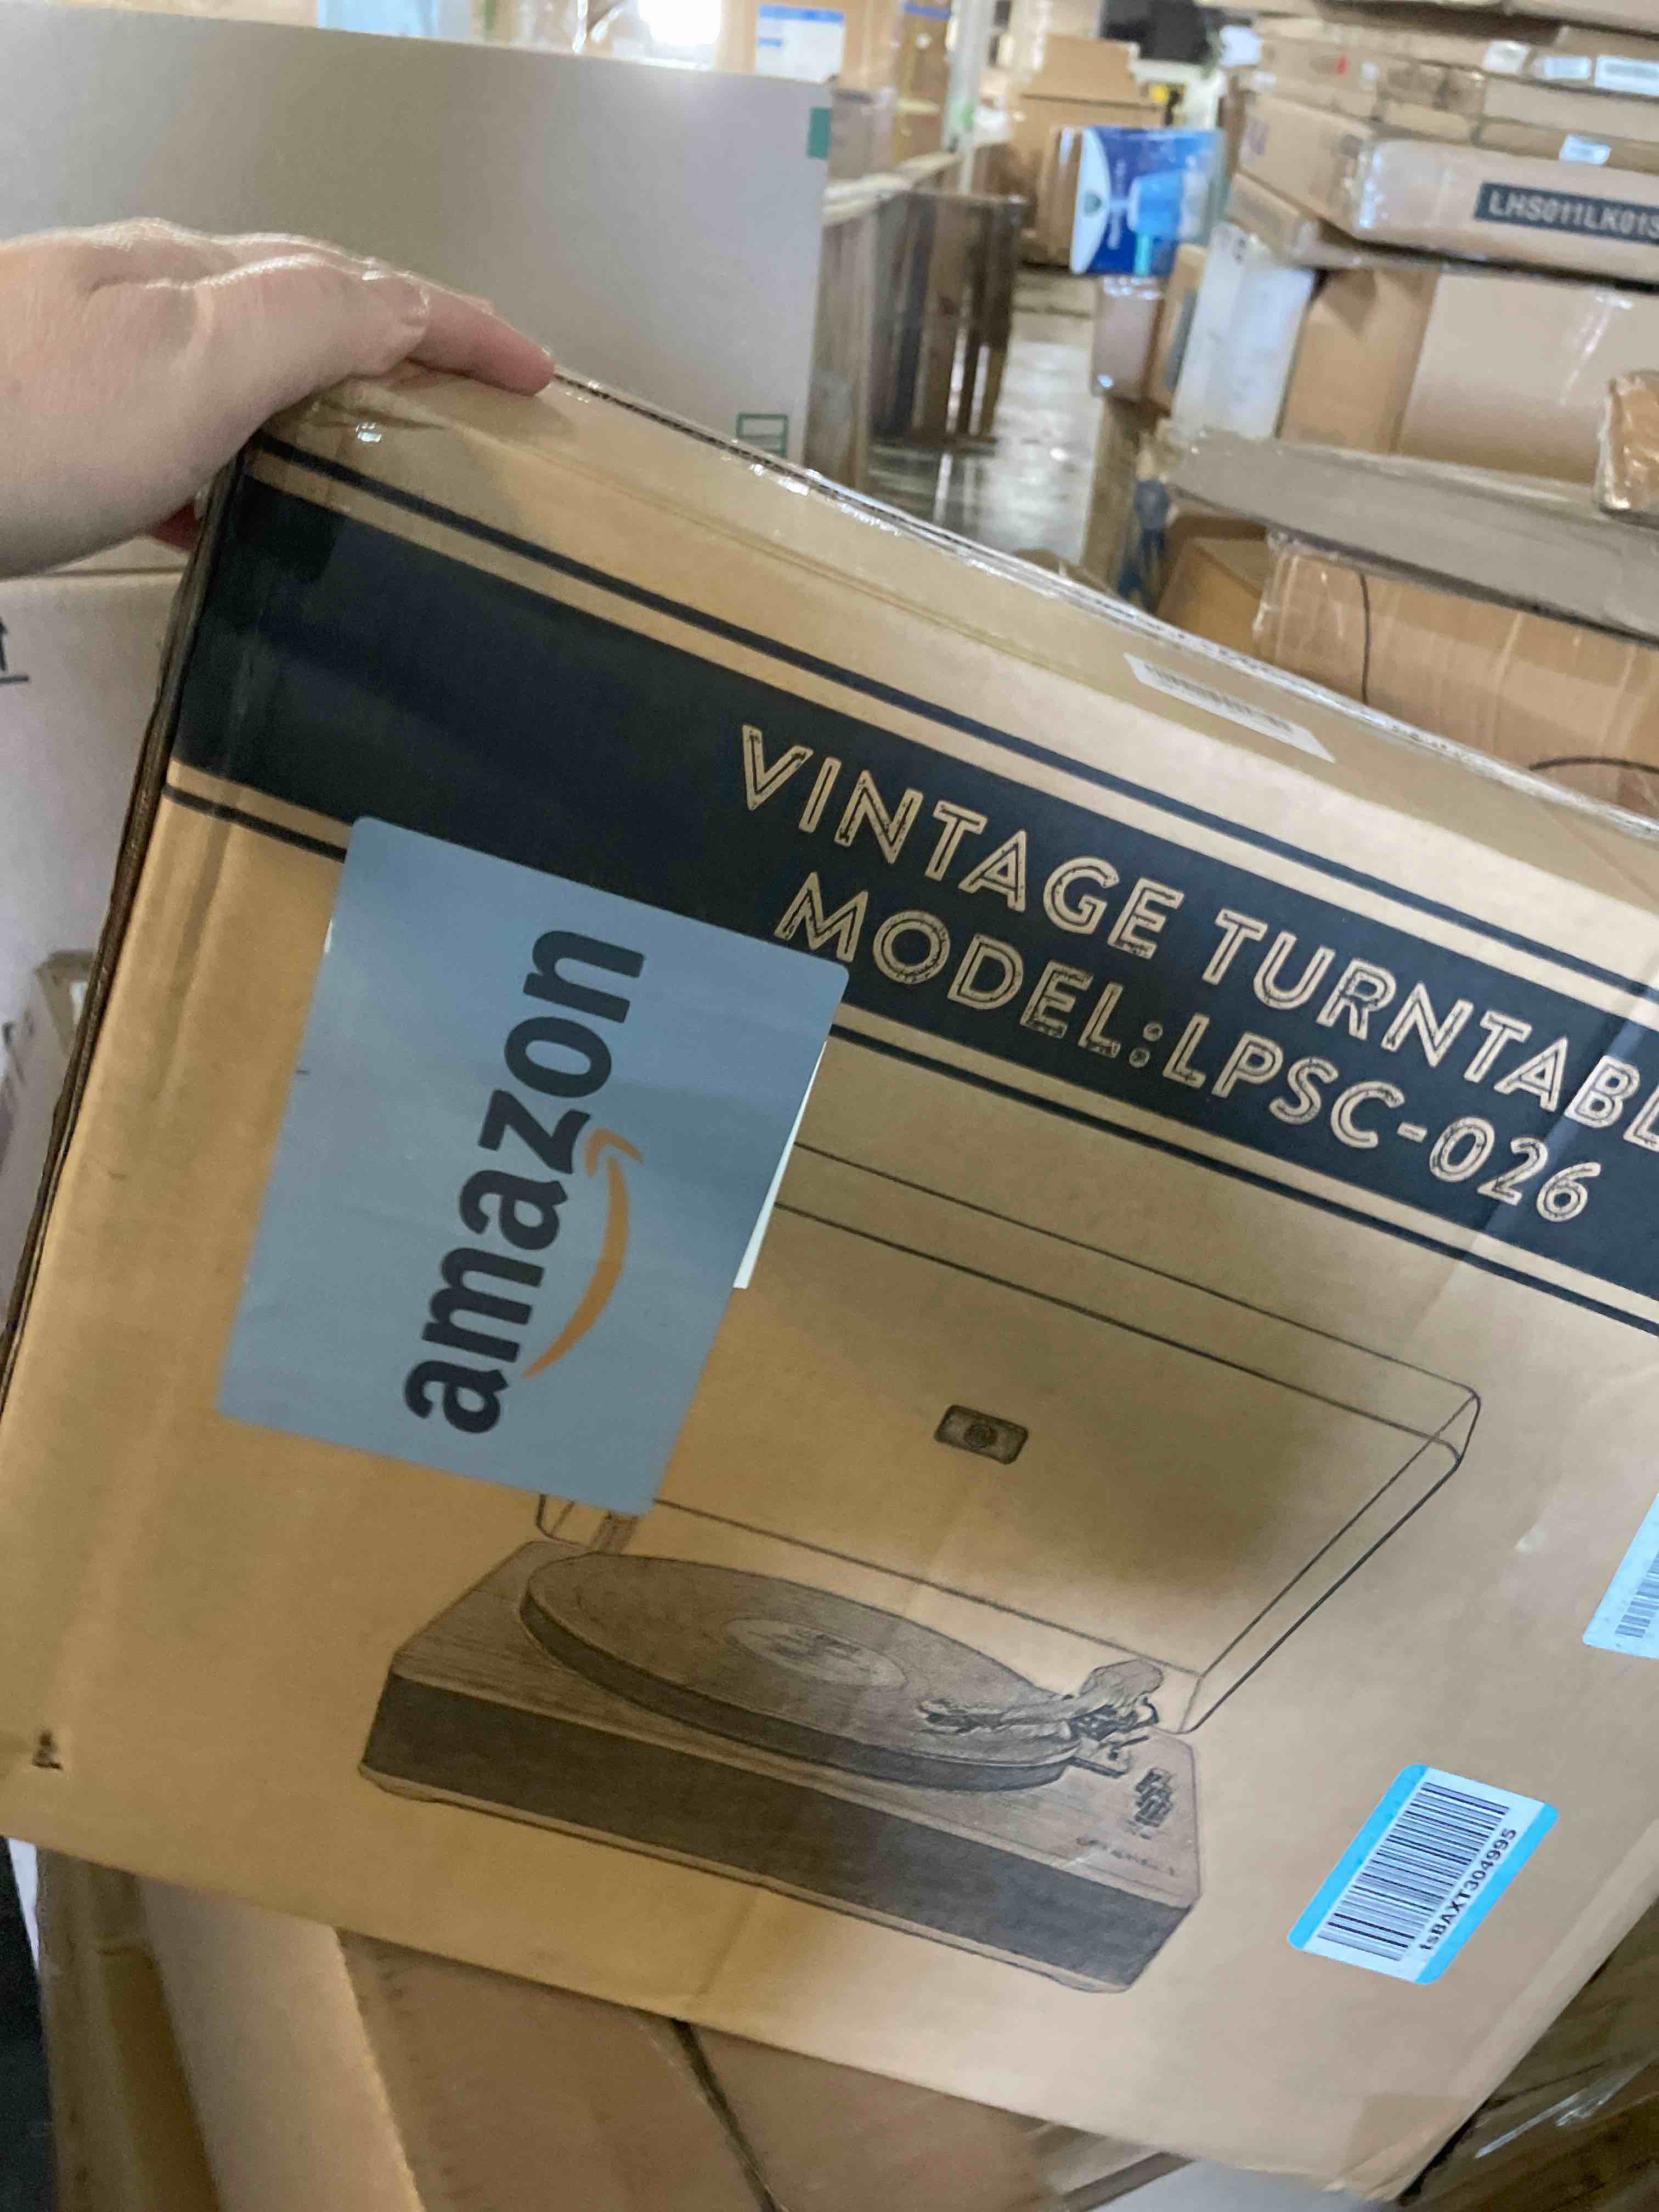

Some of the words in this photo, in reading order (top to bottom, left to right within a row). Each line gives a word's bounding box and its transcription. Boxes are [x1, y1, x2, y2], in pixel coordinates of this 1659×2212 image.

[742, 724, 1186, 960] VINTAGE
[404, 930, 645, 1434] amazon
[774, 871, 1602, 1222] MODEL:LPSC-026
